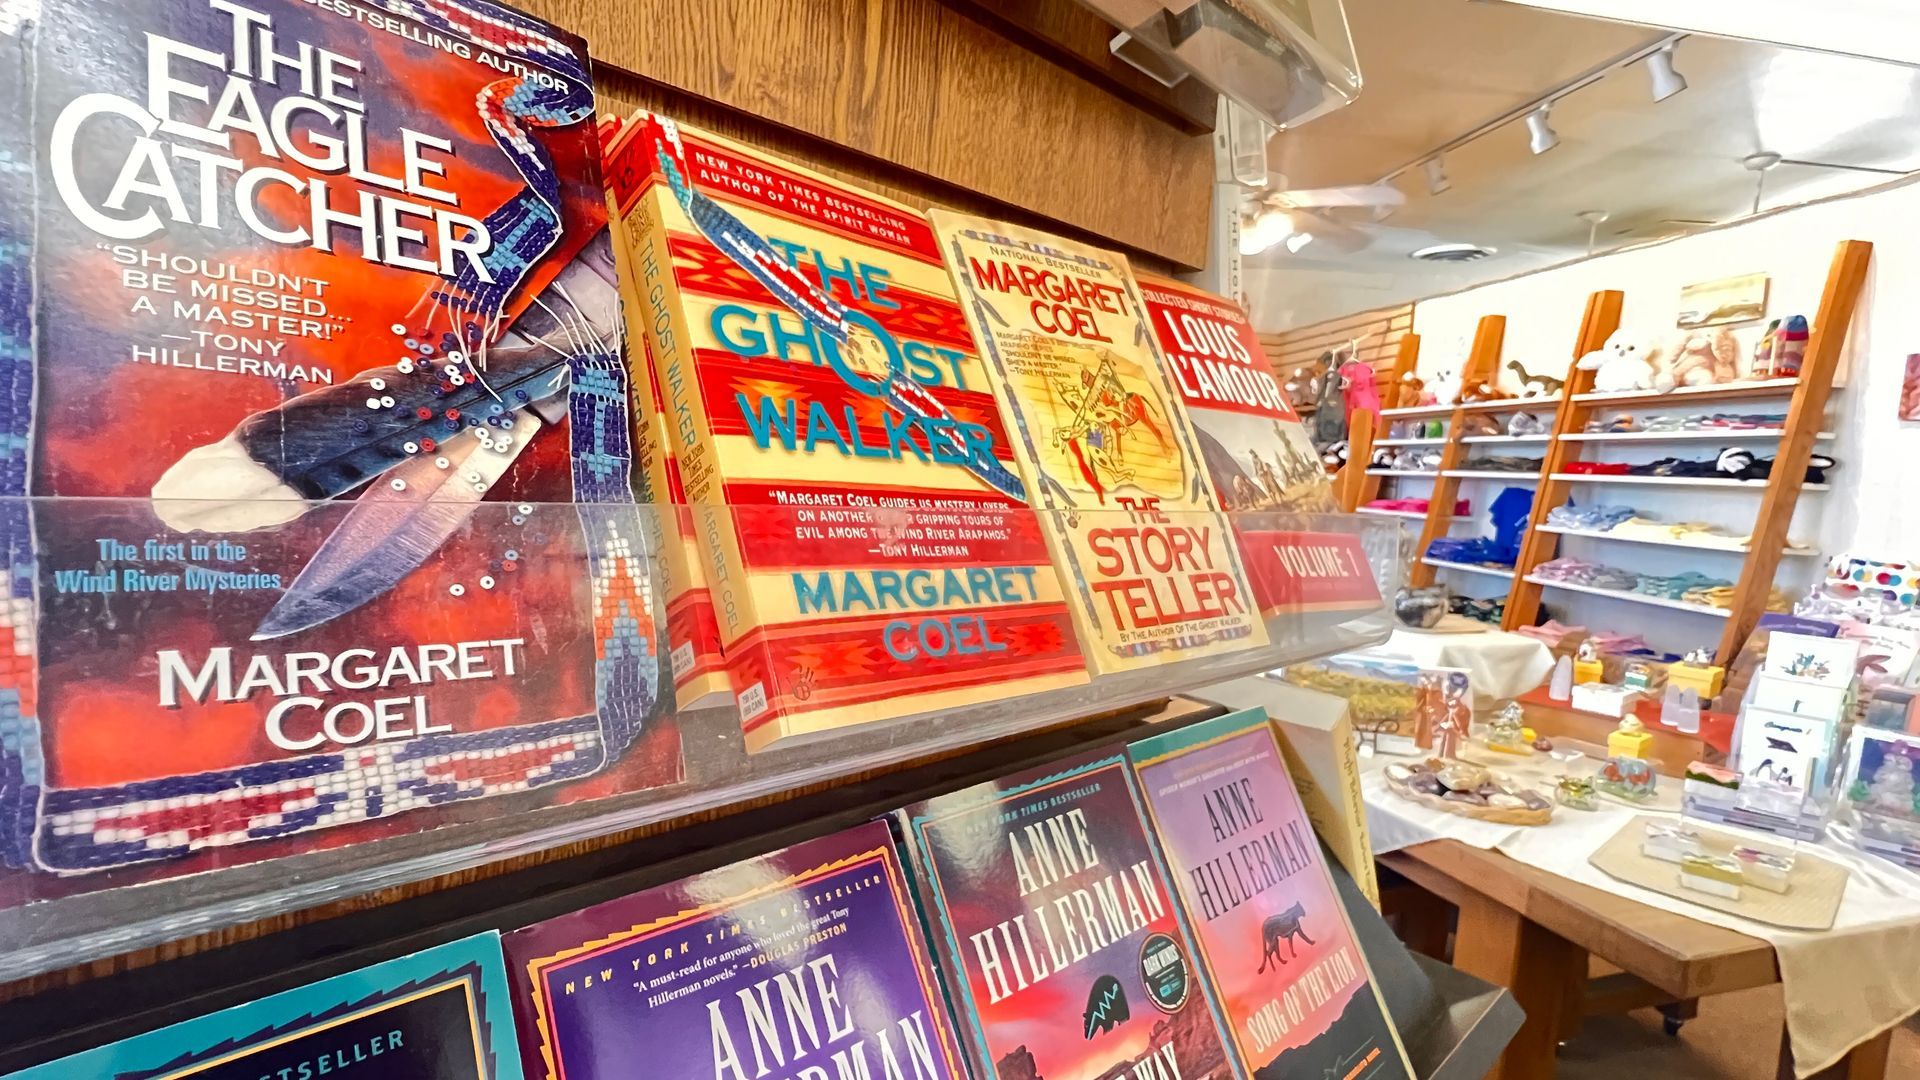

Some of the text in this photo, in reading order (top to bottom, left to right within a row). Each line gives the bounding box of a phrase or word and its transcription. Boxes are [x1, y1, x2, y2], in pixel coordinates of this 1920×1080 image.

[207, 0, 364, 112] THE
[475, 49, 570, 95] AUTHOR
[144, 31, 457, 206] EAGLE
[50, 92, 497, 284] CATCHER
[695, 152, 906, 231] NEW YORK TIMES BESTSELLING
[700, 169, 912, 245] AUTHOR OF THE SPIRIT WOMAN
[96, 243, 330, 297] "SHOULDN'T
[767, 235, 901, 310] THE
[968, 257, 1130, 317] MARGARET
[989, 245, 1102, 279] NATIONAL BESTSELLER
[122, 268, 353, 323] BE MISSED...
[130, 295, 345, 340] A MASTER!"
[1029, 299, 1114, 345] COEL
[132, 344, 334, 385] HILLERMAN
[640, 238, 660, 288] THE
[650, 283, 677, 360] GHOST
[667, 357, 697, 450] WALKER
[709, 304, 968, 397] GHOST
[1162, 309, 1252, 365] LOUIS
[1166, 352, 1290, 413] L'AMOUR
[736, 393, 998, 468] WALKER
[684, 463, 714, 497] BESTSELLING
[846, 493, 877, 507] COEL
[879, 496, 917, 509] GUIDES
[918, 498, 932, 509] US
[933, 500, 975, 511] MYSTERY
[795, 526, 825, 539] EVIL
[828, 527, 869, 539] AMONG
[870, 527, 894, 540] TE
[925, 527, 956, 540] RIVER
[797, 510, 816, 522] ON
[820, 510, 874, 523] ANOTHER
[915, 513, 961, 526] GRIPPING
[962, 515, 992, 526] TOURS
[993, 516, 1004, 527] OF
[1114, 496, 1171, 524] THE
[96, 538, 247, 562] The first in the
[658, 555, 673, 601] COEL
[698, 495, 740, 637] MARGARET COEL
[910, 544, 969, 557] HILLERMAN
[1087, 525, 1215, 578] STORY
[1272, 545, 1361, 579] VOLUME 1
[53, 567, 282, 596] Wind River Mysteries
[791, 565, 1040, 615] MARGARET
[1091, 571, 1246, 631] TELLER
[883, 615, 1007, 663] COEL
[1119, 632, 1130, 643] BY
[1131, 631, 1148, 640] THE
[1147, 626, 1175, 639] AUTHOR
[1175, 624, 1185, 634] OF
[1185, 623, 1198, 632] THE
[157, 637, 525, 707] MARGARET
[264, 694, 453, 751] COEL
[994, 811, 1019, 825] ORK
[1020, 799, 1049, 817] TIMES
[1050, 782, 1101, 807] BESTSELLER
[1202, 777, 1264, 844] ANNE
[1008, 807, 1100, 897] ANNE
[1189, 819, 1313, 922] HILLERMAN
[564, 874, 882, 996] NEW YORK TIMES BESTSELLER
[649, 959, 702, 989] must-read
[703, 955, 719, 969] for
[718, 943, 753, 964] anyone
[752, 934, 773, 951] who
[772, 925, 797, 944] loved
[796, 920, 811, 934] the
[810, 912, 831, 931] great
[830, 906, 850, 921] Tony
[968, 859, 1166, 1006] HILLERMAN
[647, 980, 703, 1009] Hillerman
[702, 963, 739, 987] novels."
[802, 921, 849, 948] PRESTON
[704, 953, 855, 1080] ANNE
[1246, 946, 1358, 1055] SONG OF THE LION
[258, 1029, 405, 1080] TSELLER
